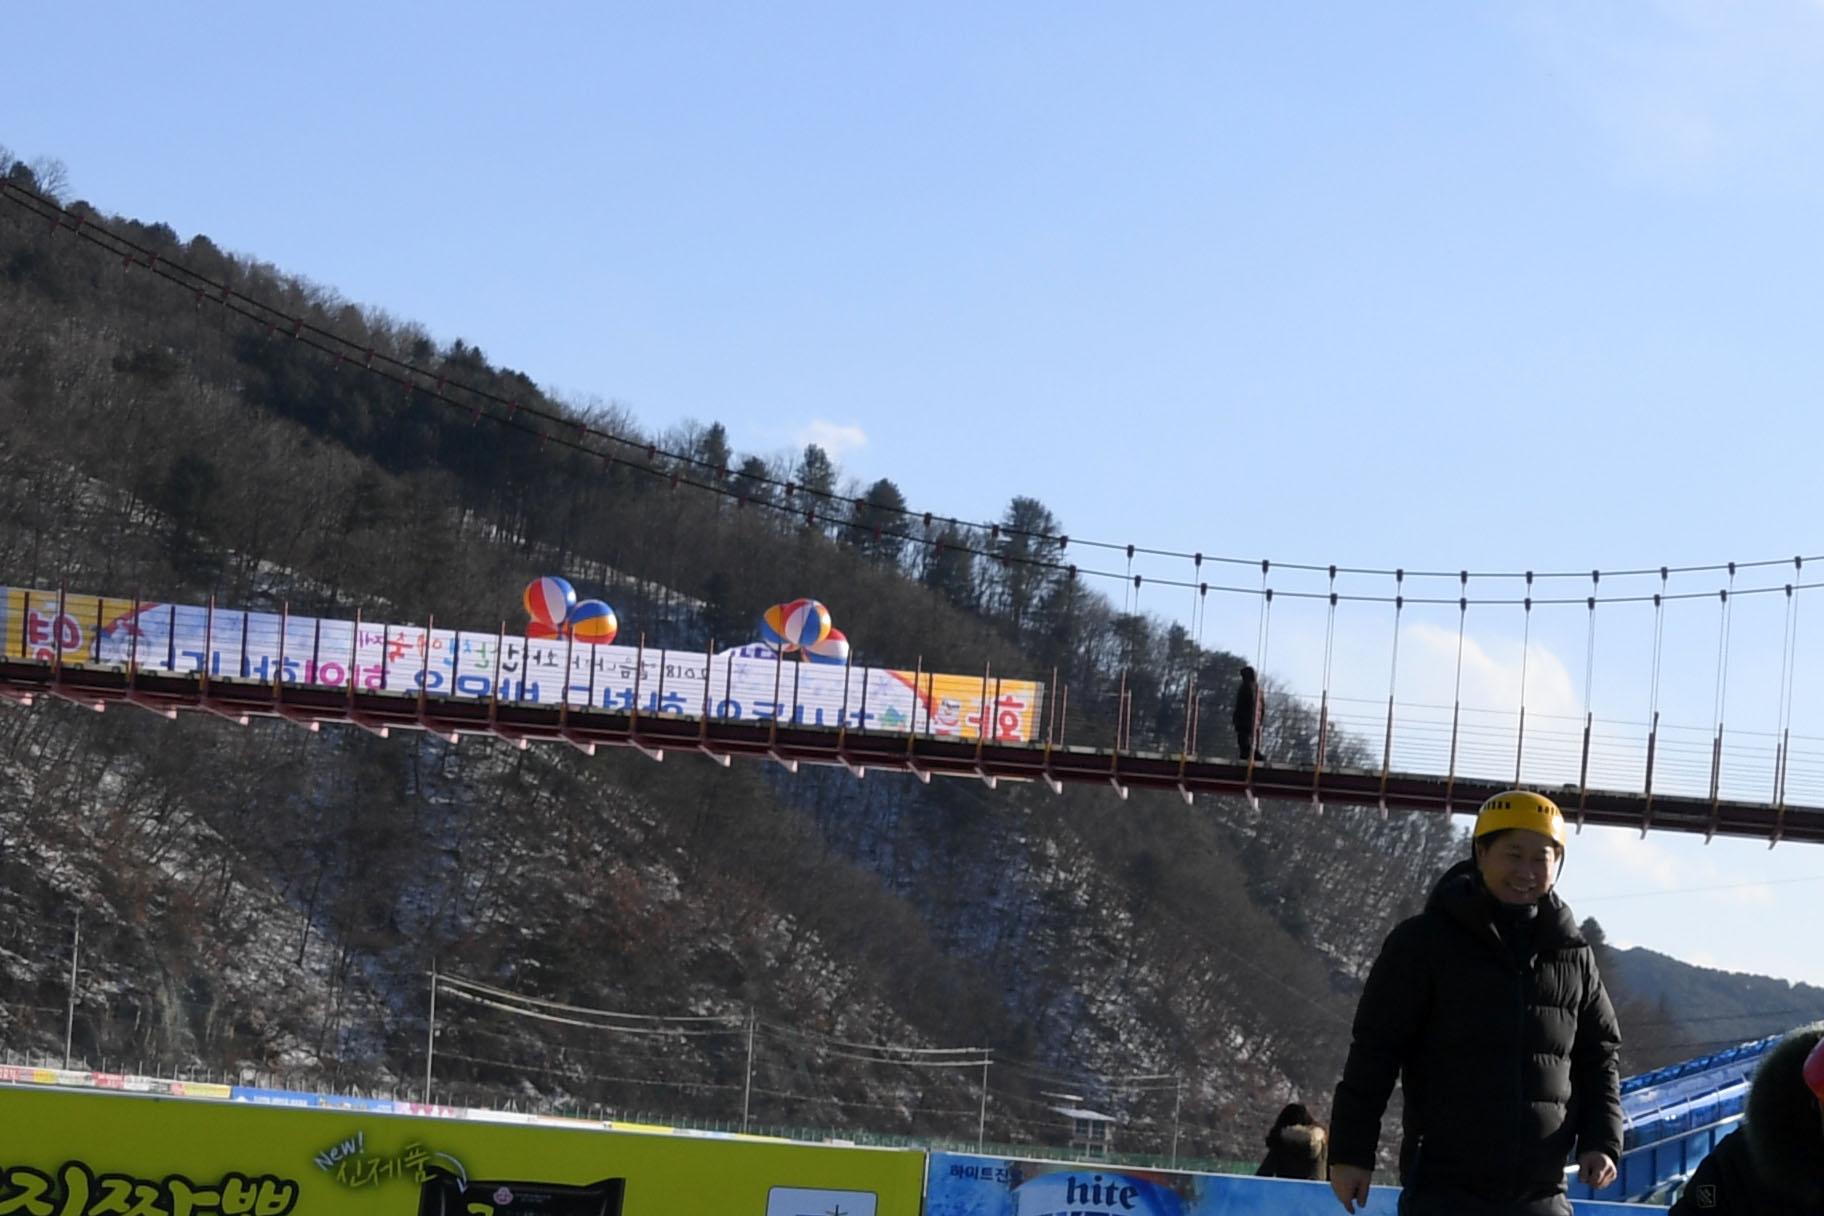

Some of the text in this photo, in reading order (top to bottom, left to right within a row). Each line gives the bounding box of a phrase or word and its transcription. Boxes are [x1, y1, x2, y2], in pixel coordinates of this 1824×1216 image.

[313, 1130, 364, 1172] New!
[336, 1142, 438, 1187] 신제품
[1067, 1176, 1140, 1210] hite
